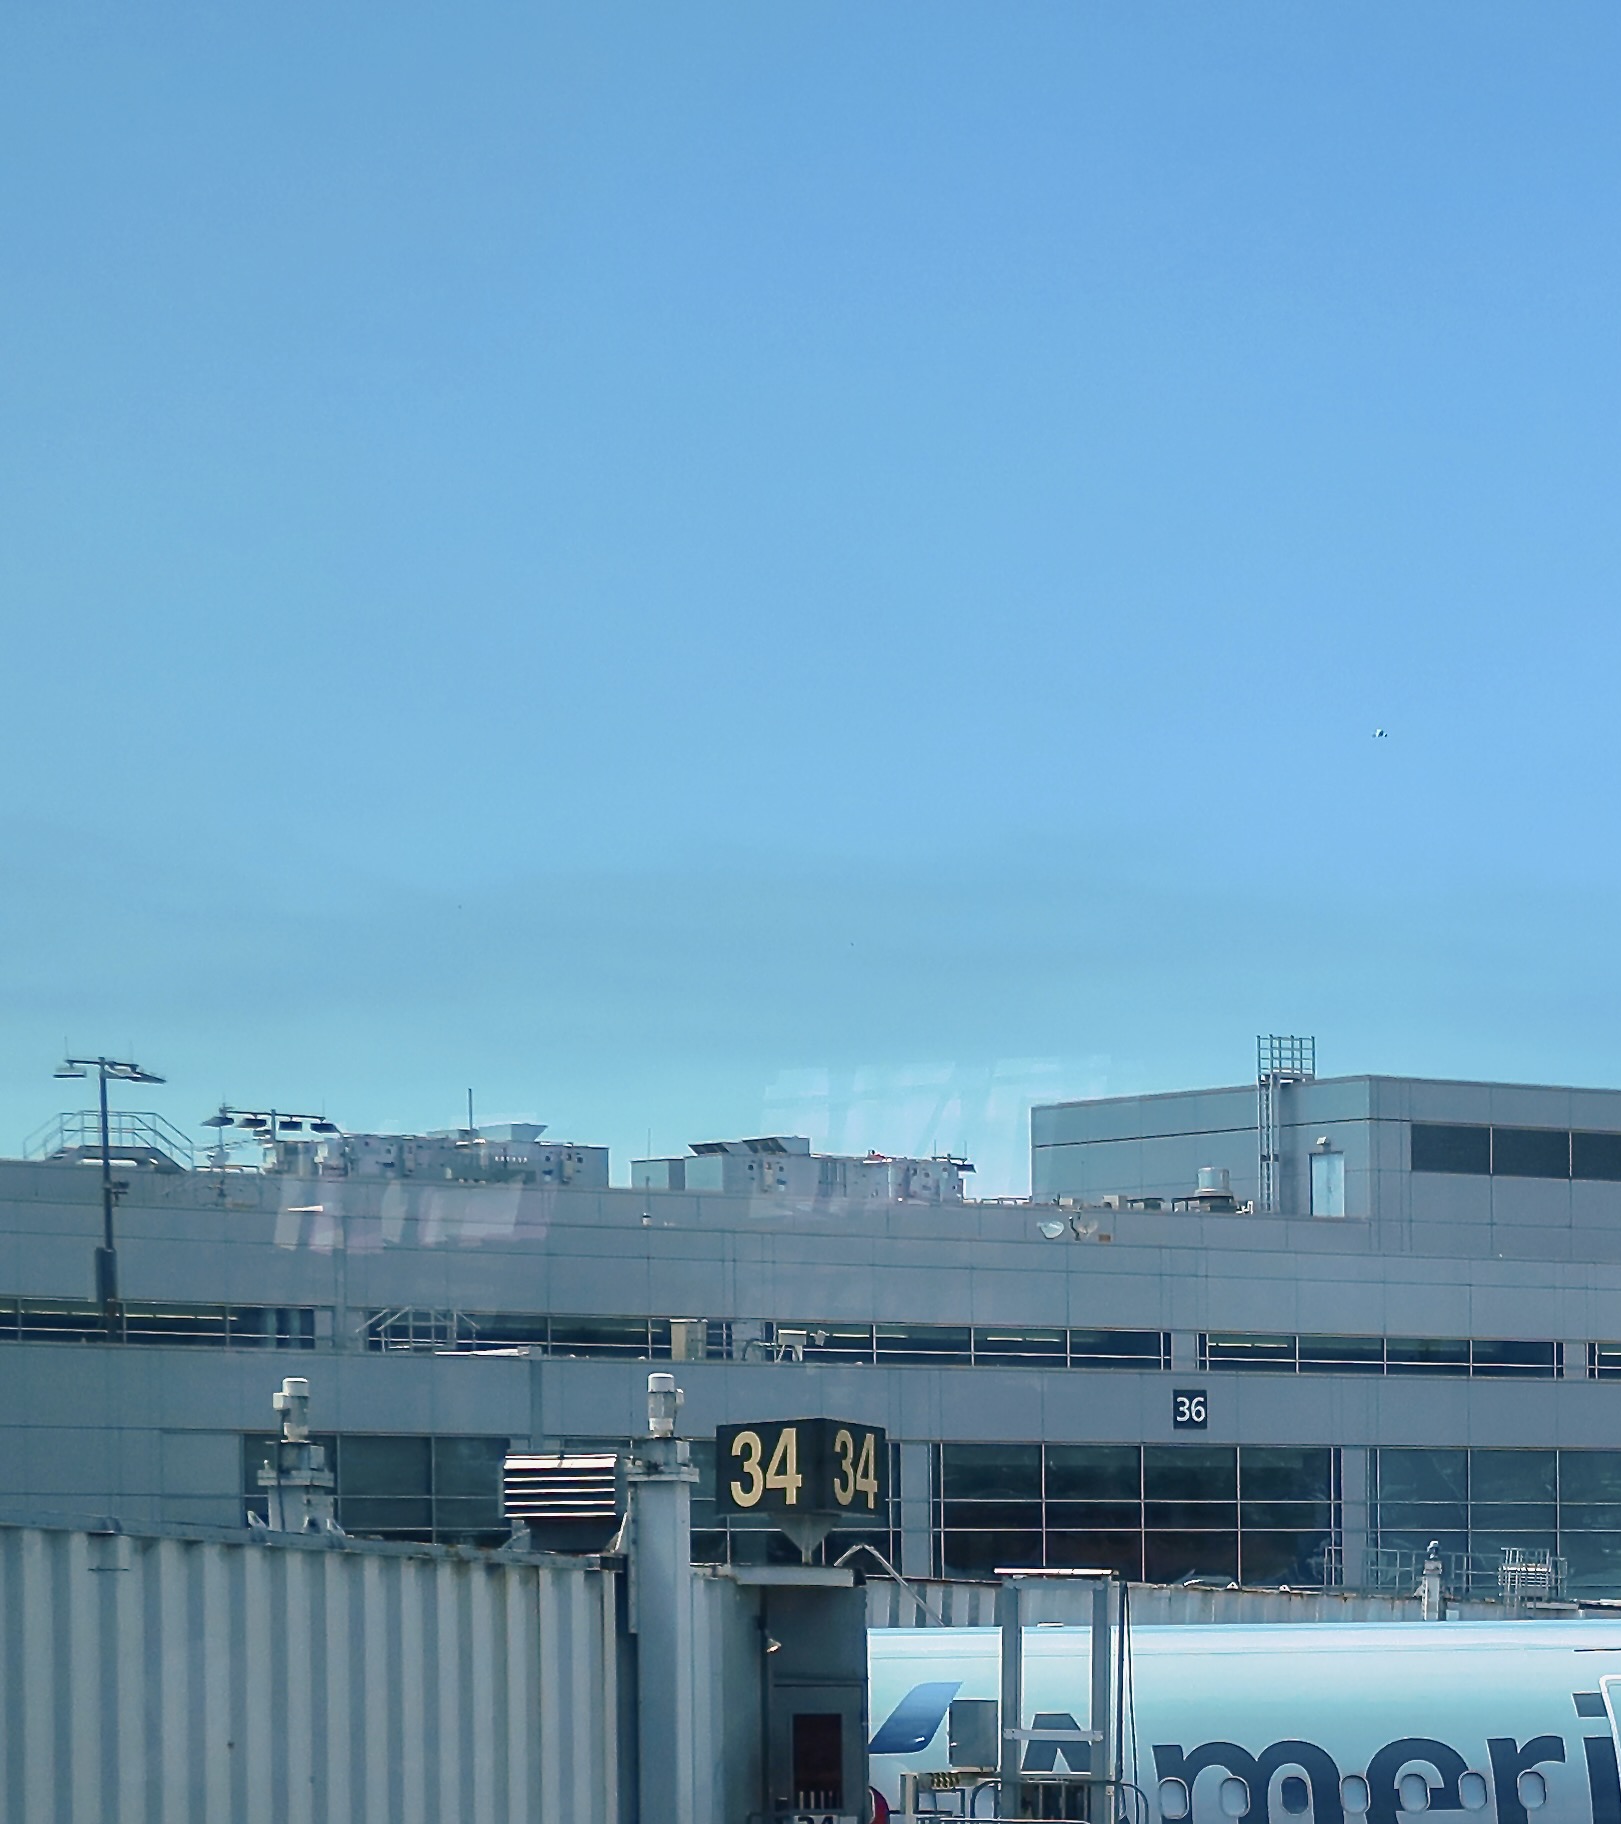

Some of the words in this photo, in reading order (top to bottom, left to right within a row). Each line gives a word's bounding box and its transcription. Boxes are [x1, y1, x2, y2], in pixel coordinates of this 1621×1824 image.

[1176, 1396, 1206, 1423] 36
[730, 1427, 802, 1508] 34
[833, 1429, 878, 1509] 34
